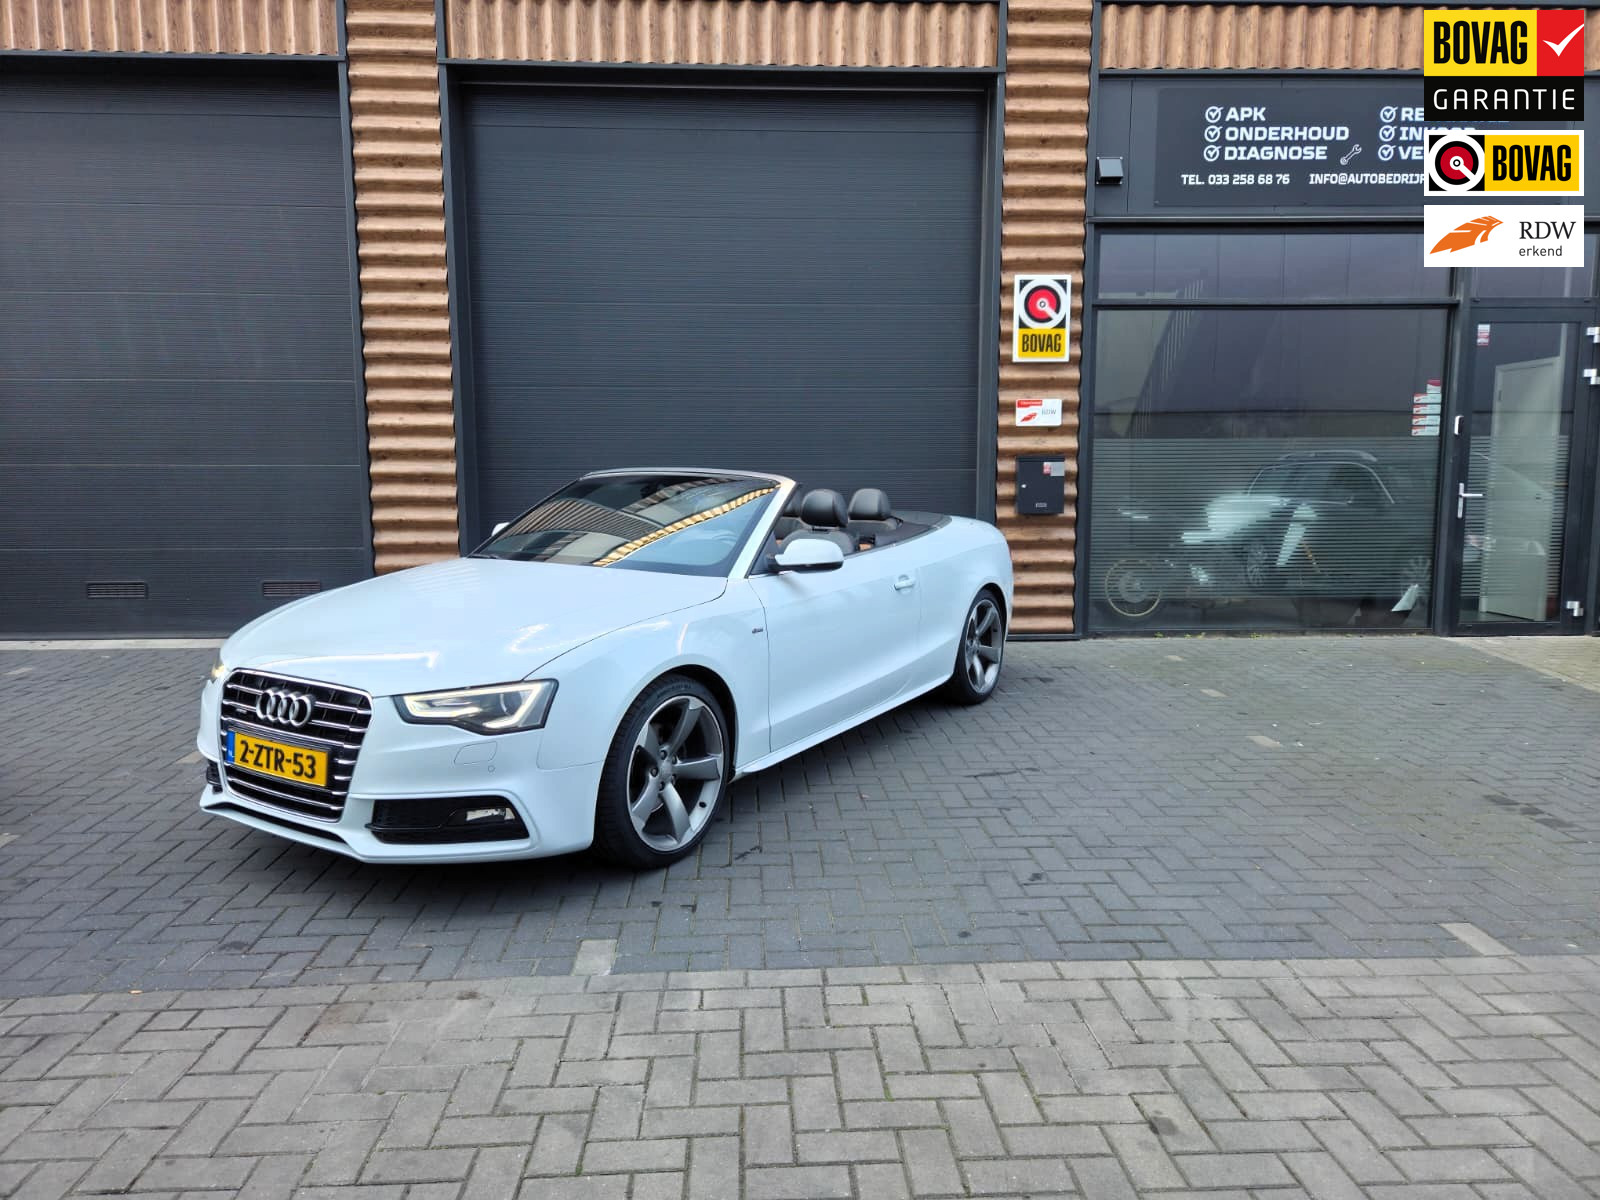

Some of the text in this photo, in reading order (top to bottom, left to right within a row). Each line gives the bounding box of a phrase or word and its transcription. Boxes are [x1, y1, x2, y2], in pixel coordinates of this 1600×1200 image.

[1225, 106, 1266, 121] APK
[1400, 107, 1424, 121] RE
[1225, 126, 1350, 141] ONDERHOUD
[1224, 145, 1328, 161] DIAGNOSE
[1398, 145, 1424, 160] VE
[1180, 173, 1290, 185] TEL. 033 258 68 76
[1308, 172, 1424, 185] INFO@AUTOBEDRIJF
[1021, 333, 1062, 353] BOVAG
[239, 739, 317, 780] 2-ZTR-53
